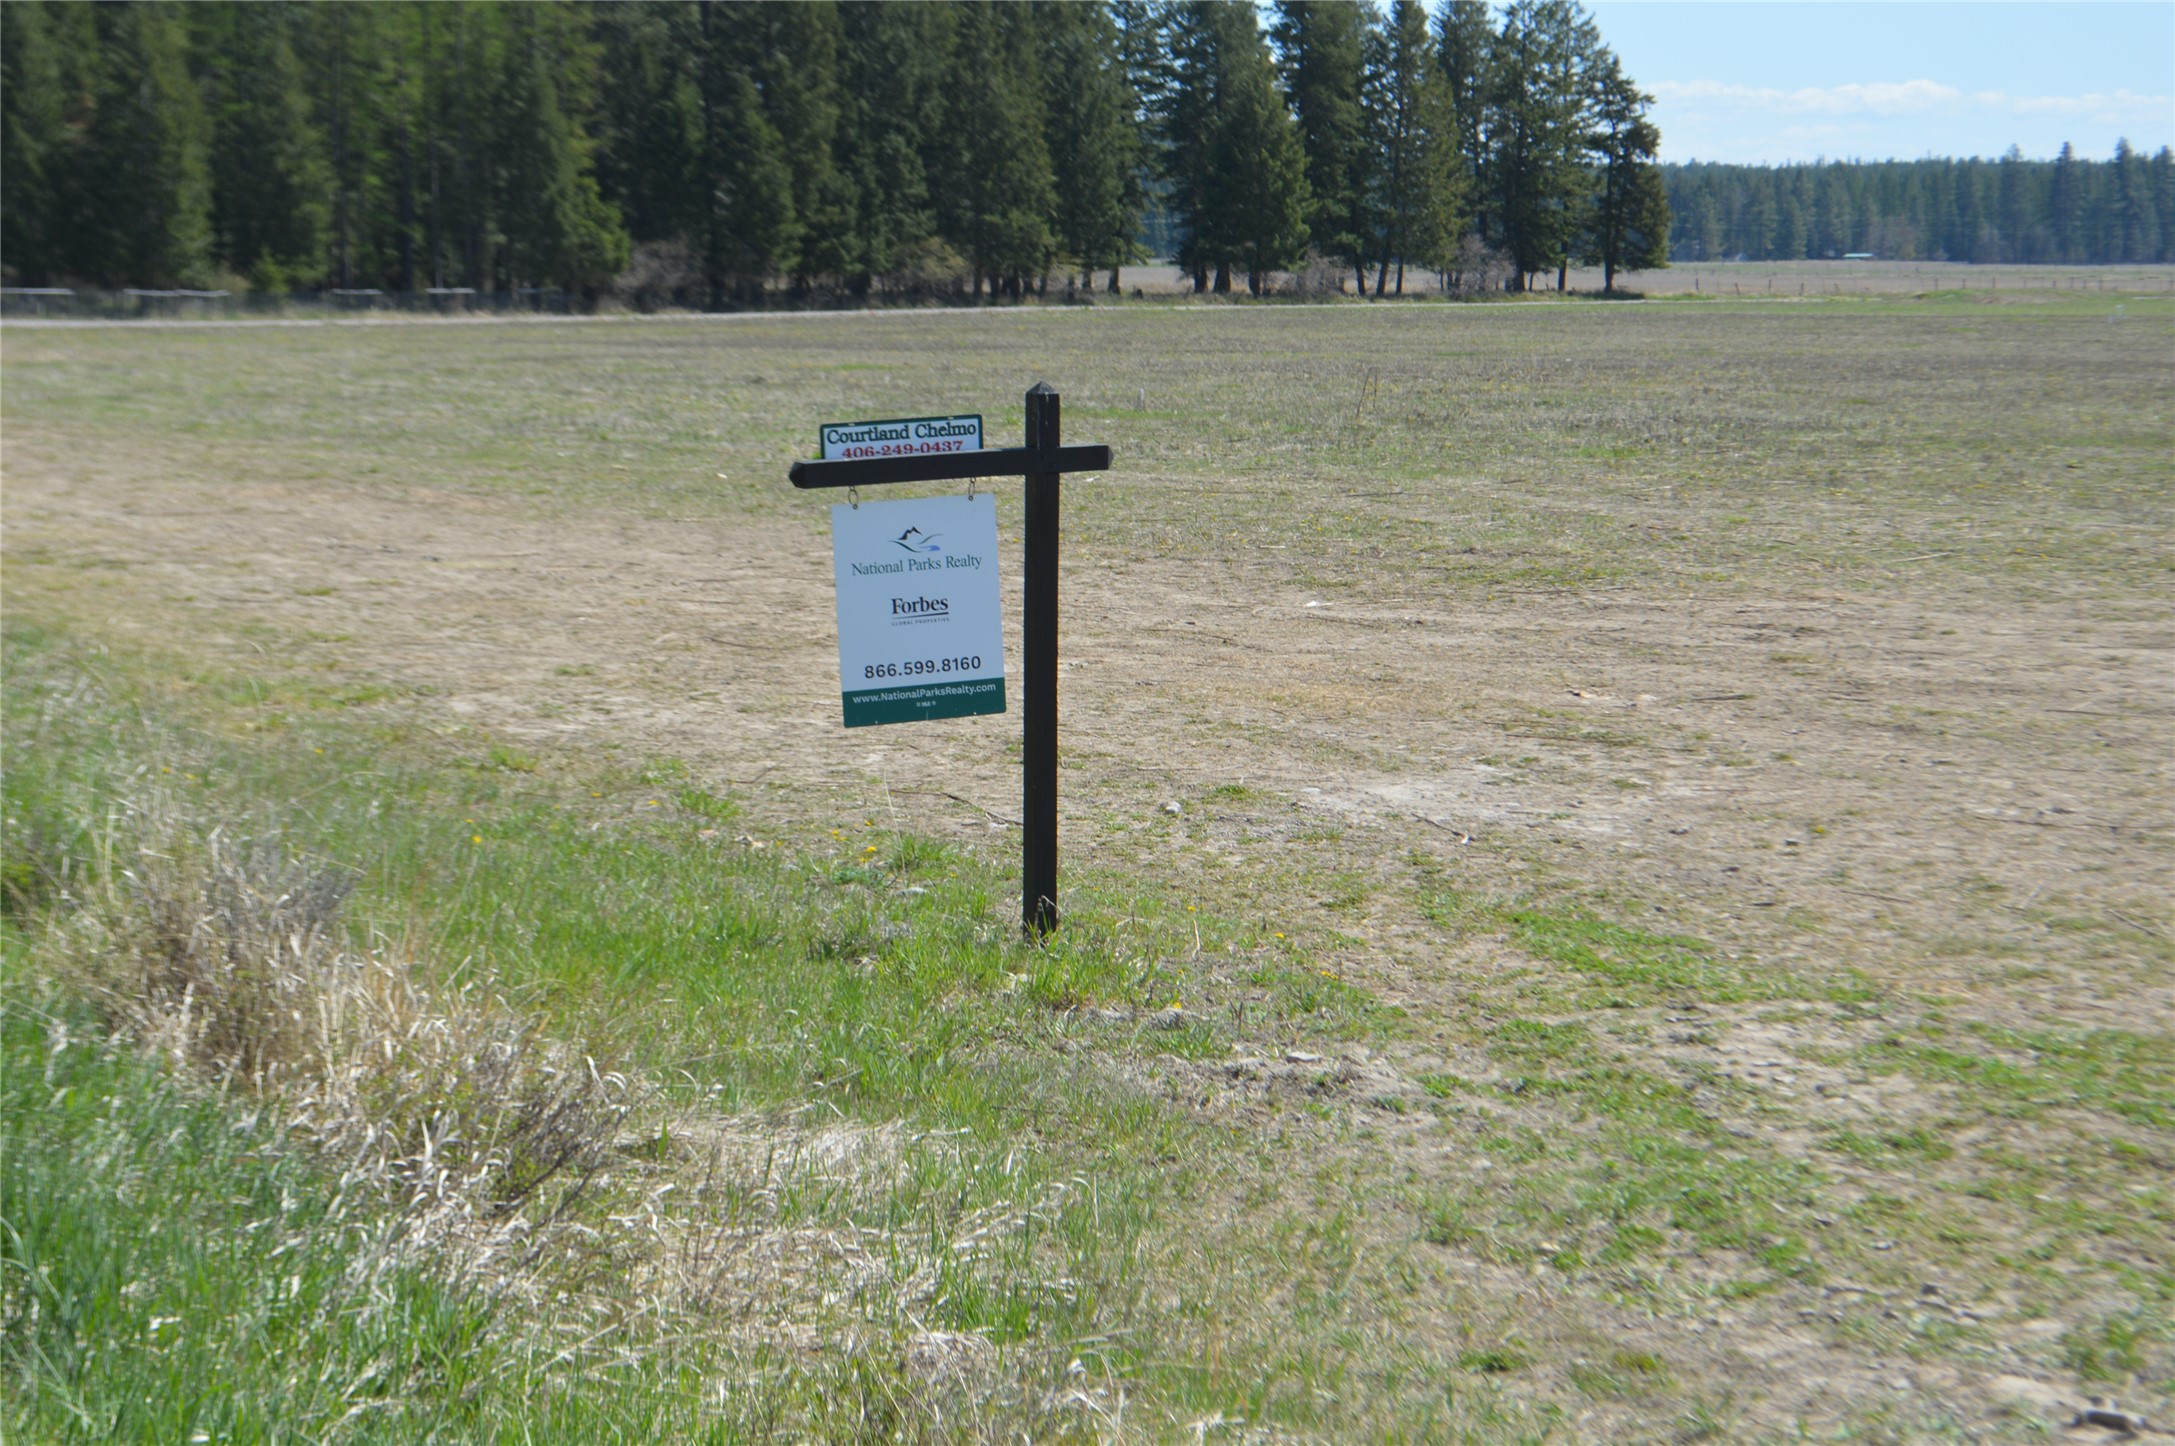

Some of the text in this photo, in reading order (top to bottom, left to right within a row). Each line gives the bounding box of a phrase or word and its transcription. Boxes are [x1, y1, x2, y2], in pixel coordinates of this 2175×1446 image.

[827, 422, 977, 444] Courtland Chelmo
[842, 441, 963, 458] 406-249-0437
[851, 554, 982, 576] National Parks Realty
[891, 596, 949, 614] Forbes
[865, 656, 981, 679] 866.599.8160
[852, 683, 996, 704] www.NationalParksRealty.com
